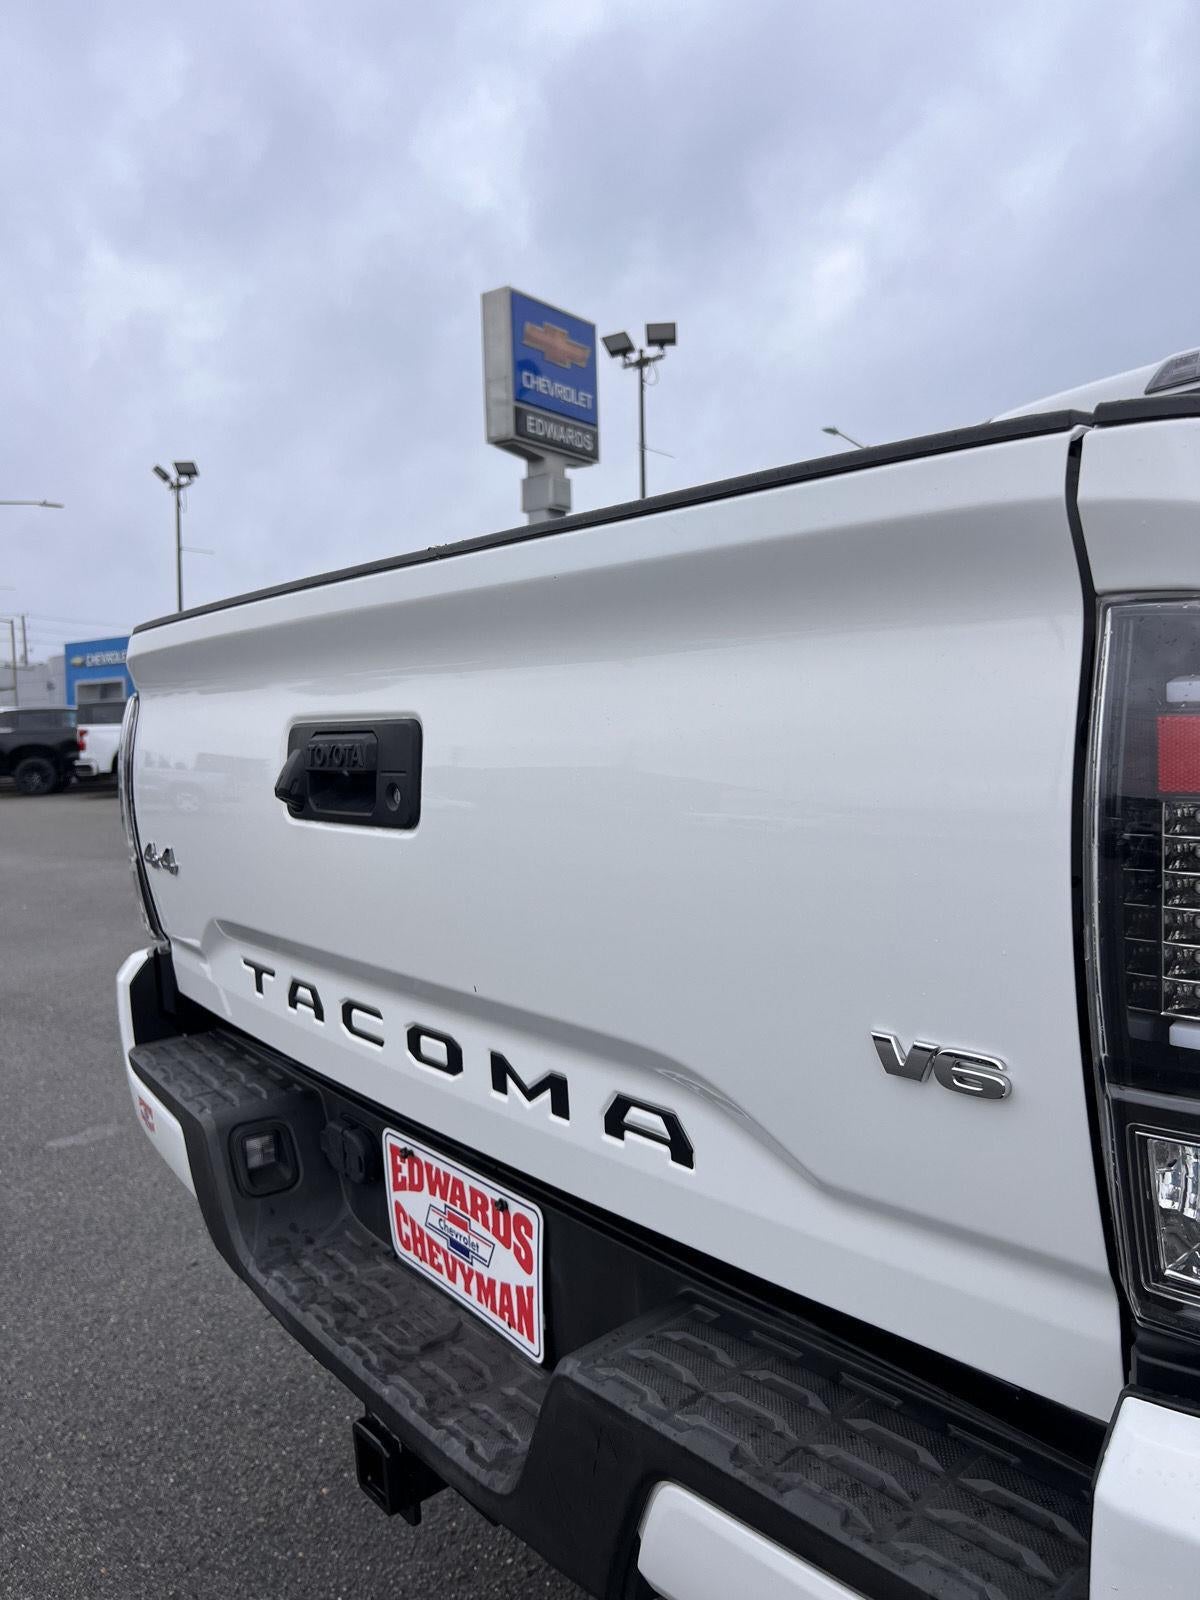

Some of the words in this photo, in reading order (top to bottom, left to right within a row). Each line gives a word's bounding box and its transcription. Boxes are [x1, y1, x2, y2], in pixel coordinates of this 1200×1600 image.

[521, 370, 593, 410] CHEVROLET
[526, 415, 594, 451] EDWARDS
[86, 649, 128, 668] CHEVROLE
[307, 744, 366, 768] TOYOTA
[242, 957, 695, 1170] TACOMA
[871, 1031, 1012, 1100] V6
[390, 1143, 534, 1275] EDWARDS
[438, 1217, 480, 1253] Chevrolet
[394, 1200, 534, 1344] CHEVYMAN
